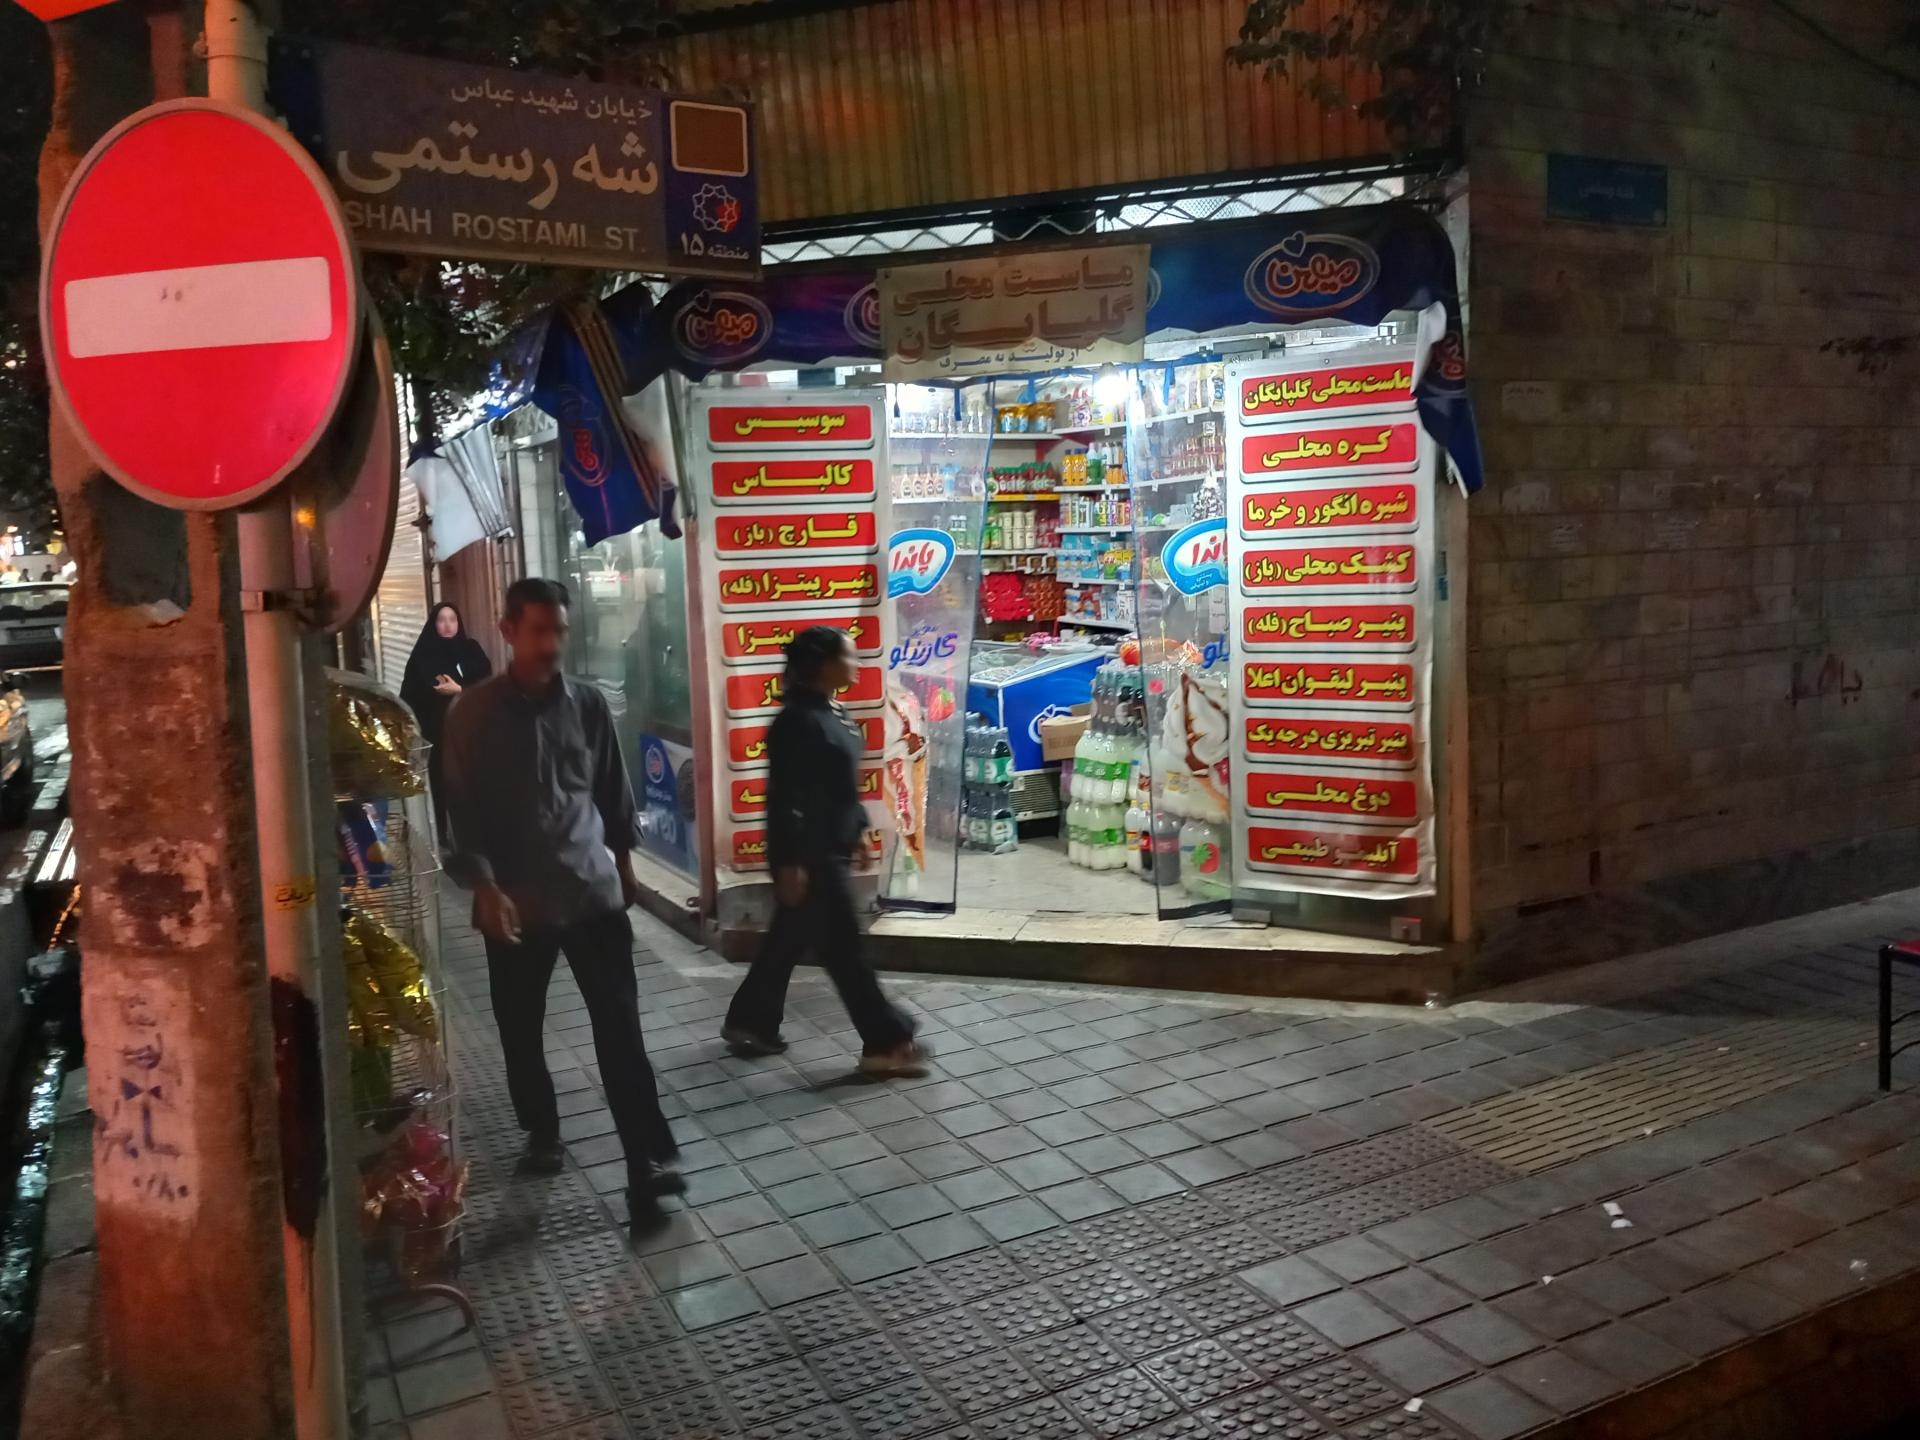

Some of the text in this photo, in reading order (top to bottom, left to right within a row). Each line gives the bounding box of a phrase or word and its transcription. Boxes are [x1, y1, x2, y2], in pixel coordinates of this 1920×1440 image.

[450, 79, 653, 124] خیابان شهید عباس
[337, 120, 659, 210] شه رستمی
[346, 201, 647, 253] SHAH ROSTAMI ST.
[681, 232, 750, 259] منطقه ۱۵
[1004, 255, 1134, 298] ماست
[1265, 252, 1361, 298] میهن
[893, 269, 994, 316] محلی
[1244, 369, 1412, 410] ماست محلی گلپایگان
[734, 412, 846, 435] سوسیس
[1262, 429, 1392, 467] کره محلی
[732, 463, 854, 496] کالباس
[1247, 492, 1409, 527] شیره انگور و خرما
[733, 512, 858, 547] قارچ (باز)
[1244, 550, 1412, 583] کشک محلی (باز)
[722, 574, 761, 598] (فله)
[762, 570, 823, 600] پیتزا
[823, 570, 874, 598] پنیر
[1247, 610, 1407, 640] پنیر صباح (فله)
[1246, 667, 1408, 698] پنیر لیقوان اعلا
[1247, 723, 1276, 746] یک
[1320, 727, 1376, 752] تبریزی
[1376, 729, 1408, 754] پنیر
[1265, 779, 1391, 812] دوغ محلی
[1261, 838, 1329, 861] طبیعی
